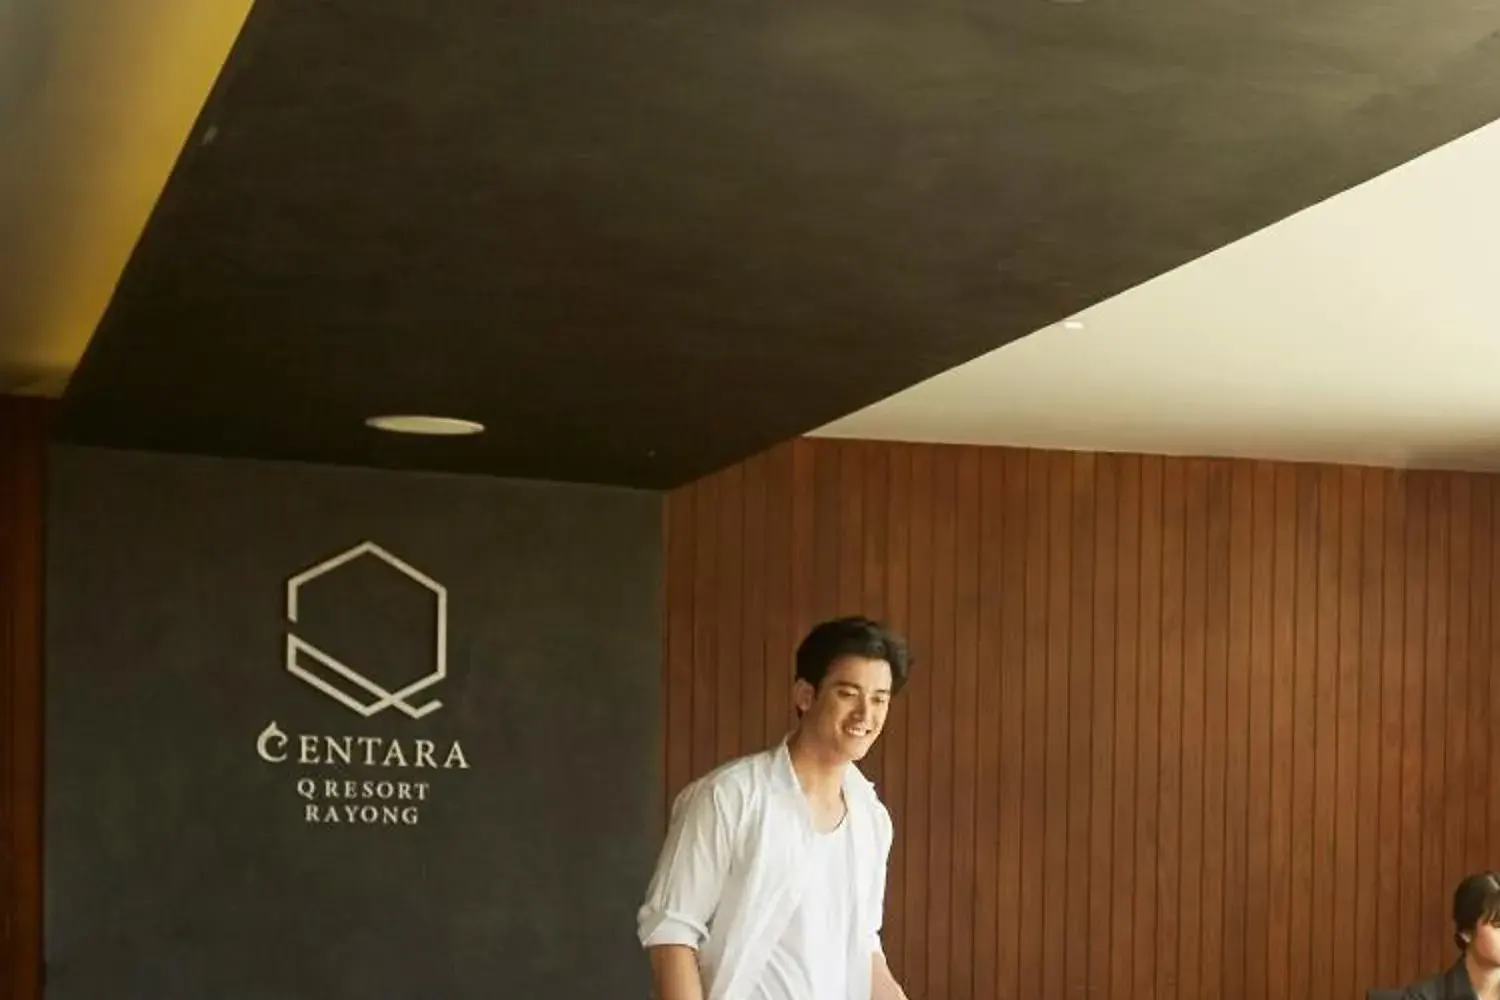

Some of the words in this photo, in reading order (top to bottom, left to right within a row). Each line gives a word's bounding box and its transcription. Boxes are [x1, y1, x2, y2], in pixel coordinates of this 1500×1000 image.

[257, 721, 470, 769] CENTARA
[297, 778, 316, 801] Q
[325, 779, 430, 801] RESORT
[305, 804, 419, 825] RAYONG
